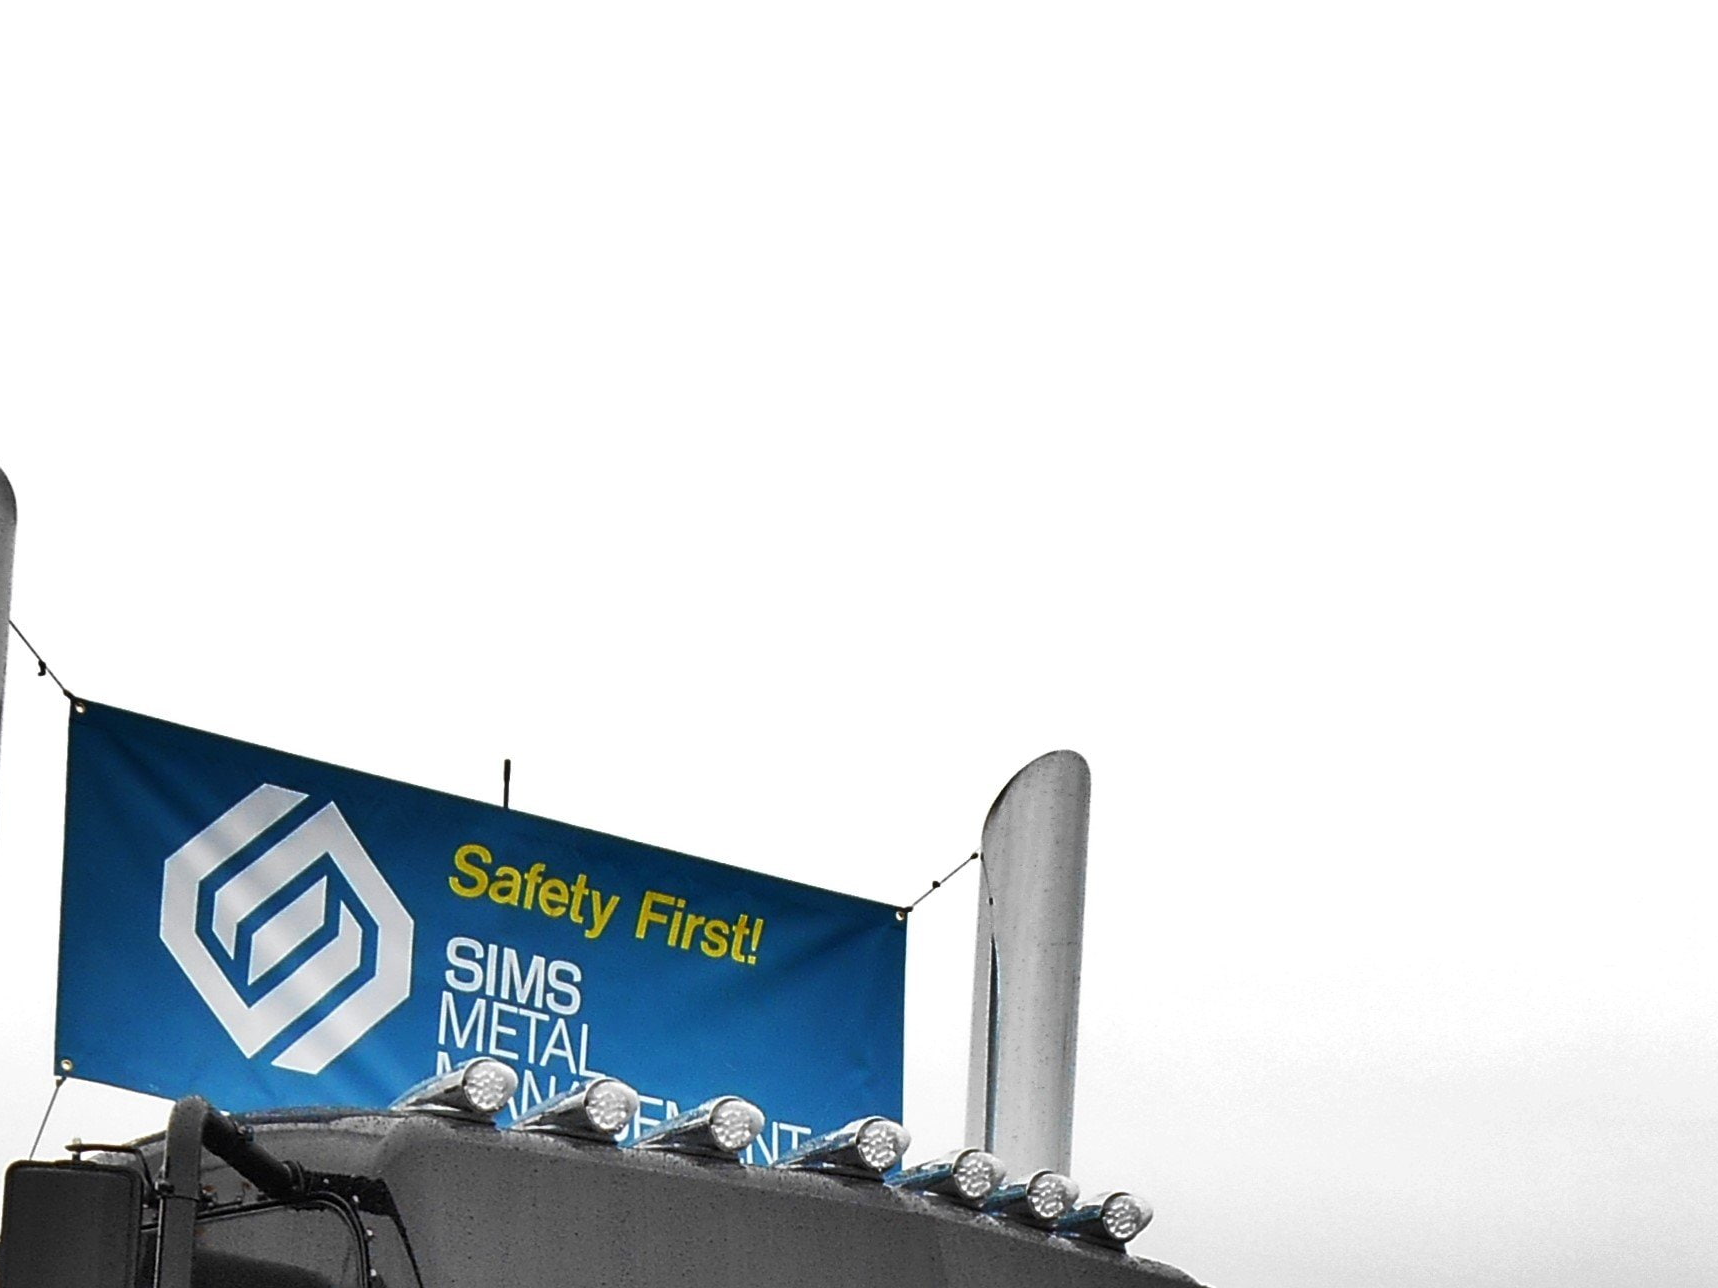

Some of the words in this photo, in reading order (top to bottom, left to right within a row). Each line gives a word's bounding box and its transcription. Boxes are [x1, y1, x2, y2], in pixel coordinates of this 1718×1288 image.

[448, 843, 620, 939] Safety
[635, 890, 765, 966] First!
[444, 936, 582, 1016] SIMS
[437, 990, 607, 1078] METAL
